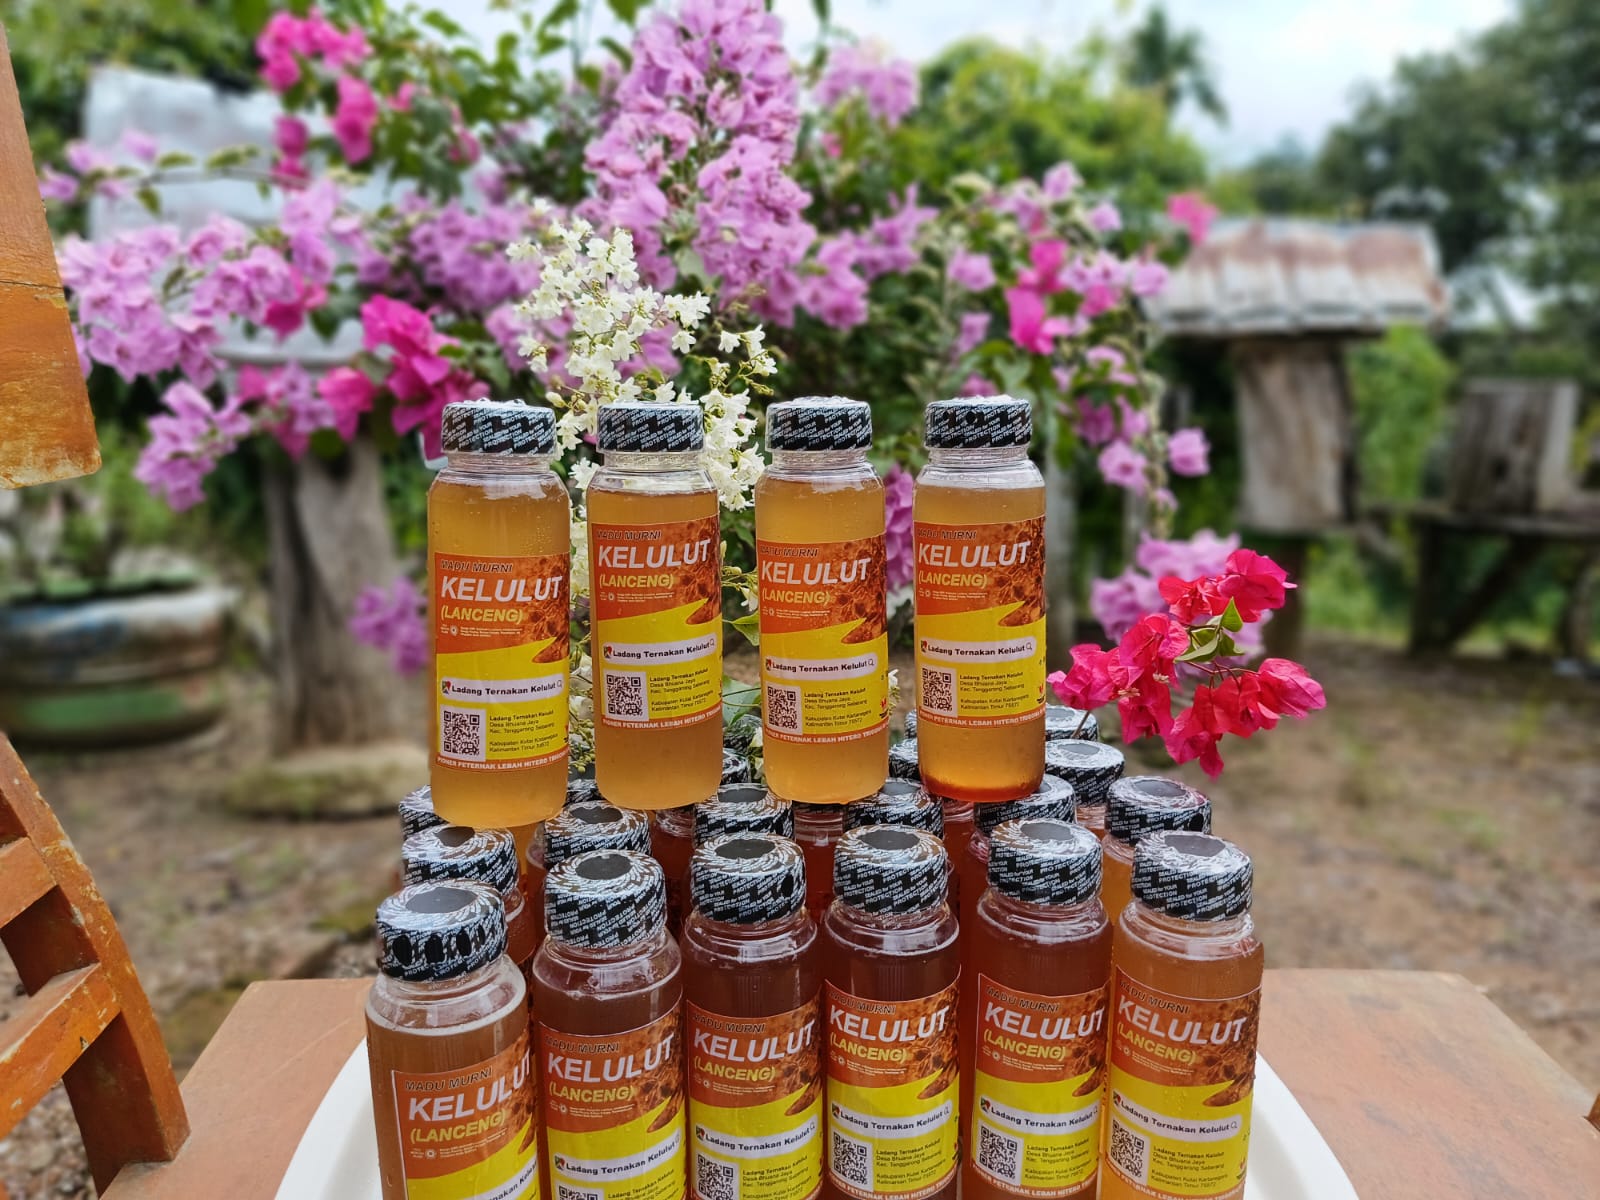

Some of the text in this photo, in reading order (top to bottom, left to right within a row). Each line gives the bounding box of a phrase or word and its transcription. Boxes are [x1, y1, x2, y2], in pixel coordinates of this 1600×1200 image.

[641, 428, 677, 449] PROTECTION
[965, 422, 1001, 443] PROTECTION
[624, 530, 662, 541] MURNI
[598, 538, 711, 569] KELULUT
[918, 541, 1031, 568] KELULUT
[440, 560, 513, 573] MADU MURNI
[761, 557, 871, 585] KELULUT
[440, 575, 563, 603] KELULUT
[599, 573, 675, 589] (LANCENG)
[918, 570, 988, 589] (LANCENG)
[762, 587, 832, 606] (LANCENG)
[440, 605, 524, 625] (LANCENG)
[612, 641, 710, 659] Ladang Ternakan Kelulut
[927, 644, 1025, 656] Ladang Ternakan Kelulut
[798, 664, 839, 672] Ternakan
[840, 660, 867, 671] Kelulut
[451, 684, 483, 696] Ladang
[485, 688, 529, 696] Ternakan
[458, 760, 497, 770] PETERNAK
[865, 886, 903, 904] PROTECTION
[893, 882, 929, 907] PROTECTION
[1166, 894, 1208, 910] PROTECTION
[1019, 999, 1060, 1013] MURNI
[1148, 996, 1190, 1015] MURNI
[725, 1023, 766, 1034] MURNI
[830, 1005, 950, 1043] KELULUT
[985, 1001, 1105, 1040] KELULUT
[1118, 995, 1248, 1045] KELULUT
[578, 1043, 620, 1054] MURNI
[693, 1019, 815, 1062] KELULUT
[830, 1032, 909, 1064] (LANCENG)
[983, 1028, 1067, 1062] (LANCENG)
[1117, 1021, 1197, 1066] (LANCENG)
[547, 1032, 675, 1083] KELULUT
[405, 1067, 493, 1092] MADU MURNI
[694, 1056, 776, 1082] (LANCENG)
[408, 1047, 531, 1122] KELULUT
[549, 1081, 638, 1103] (LANCENG)
[410, 1108, 506, 1145] (LANCENG)
[839, 1110, 943, 1130] Ladang Ternakan Kelulut
[991, 1107, 1021, 1125] Ladang
[1024, 1118, 1067, 1128] Ternakan
[1120, 1100, 1230, 1134] Ladang Ternakan Kelulut
[705, 1134, 736, 1150] Ladang
[738, 1141, 781, 1151] Ternakan
[566, 1162, 598, 1175] Ladang
[600, 1160, 646, 1175] Ternakan
